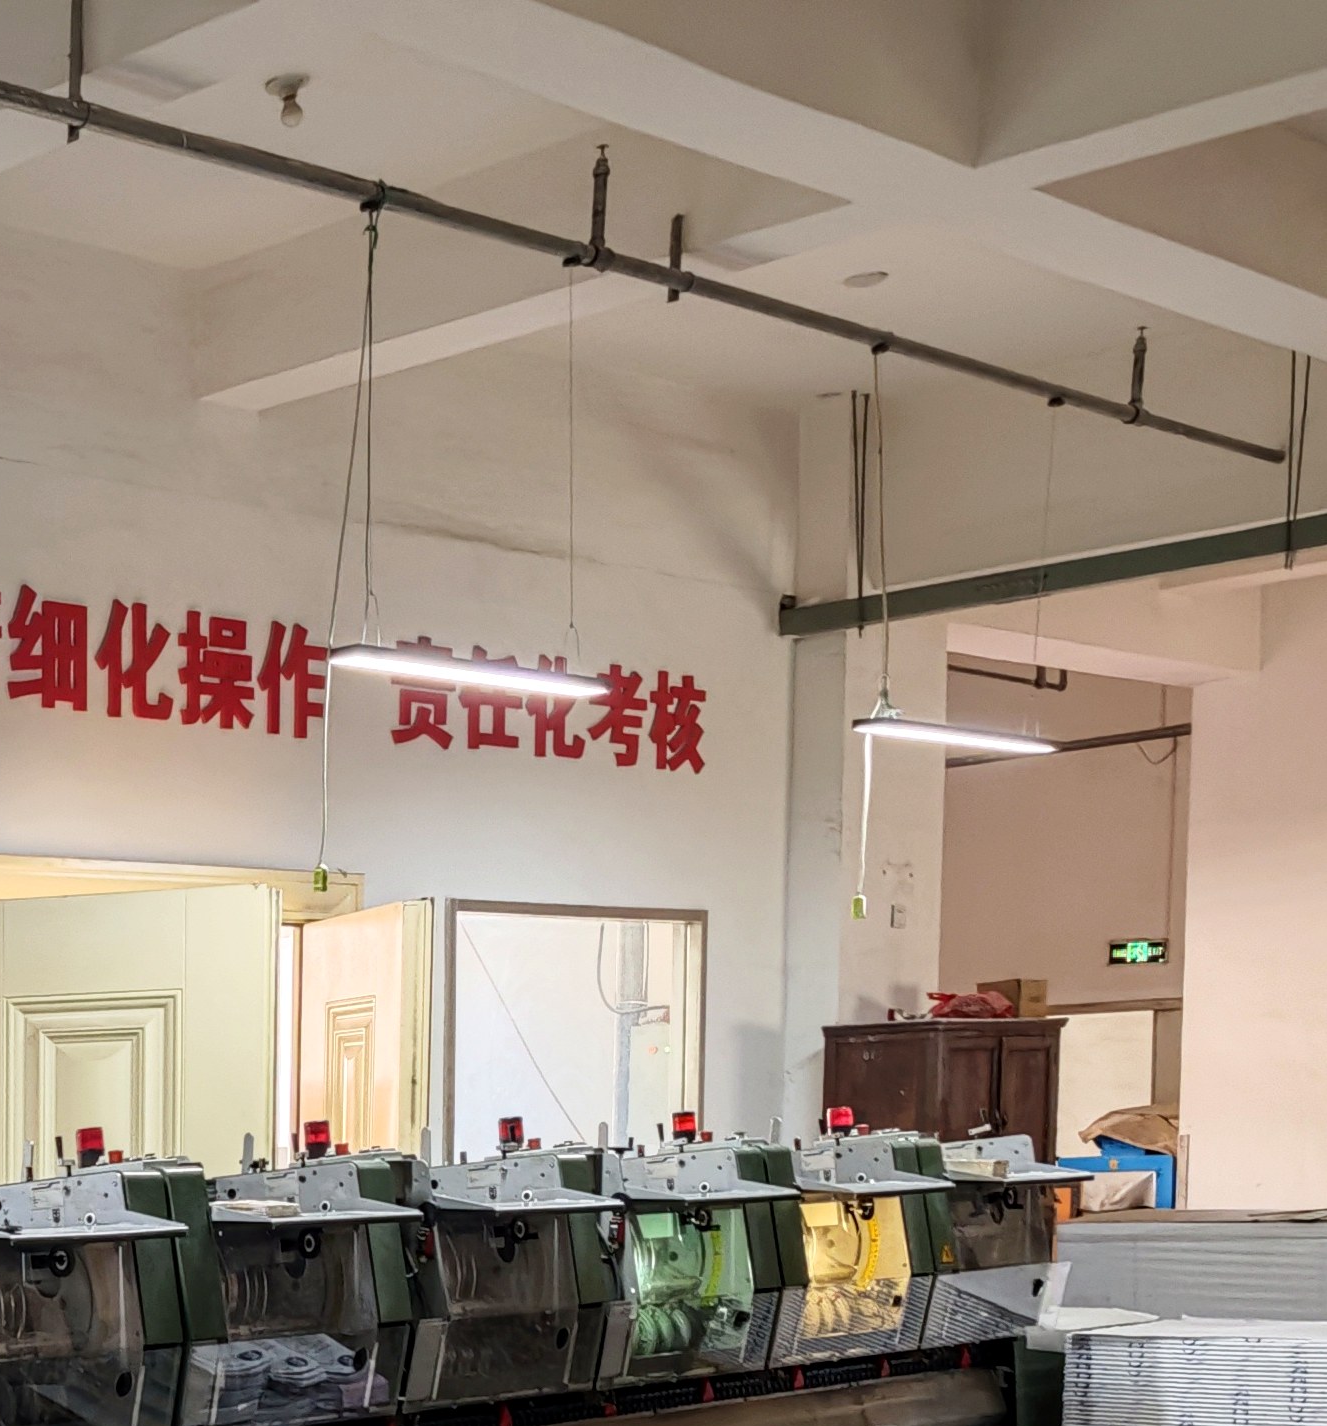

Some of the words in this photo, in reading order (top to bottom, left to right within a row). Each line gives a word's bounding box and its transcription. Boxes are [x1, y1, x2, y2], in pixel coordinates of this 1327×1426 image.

[390, 636, 708, 775] 责任化考核
